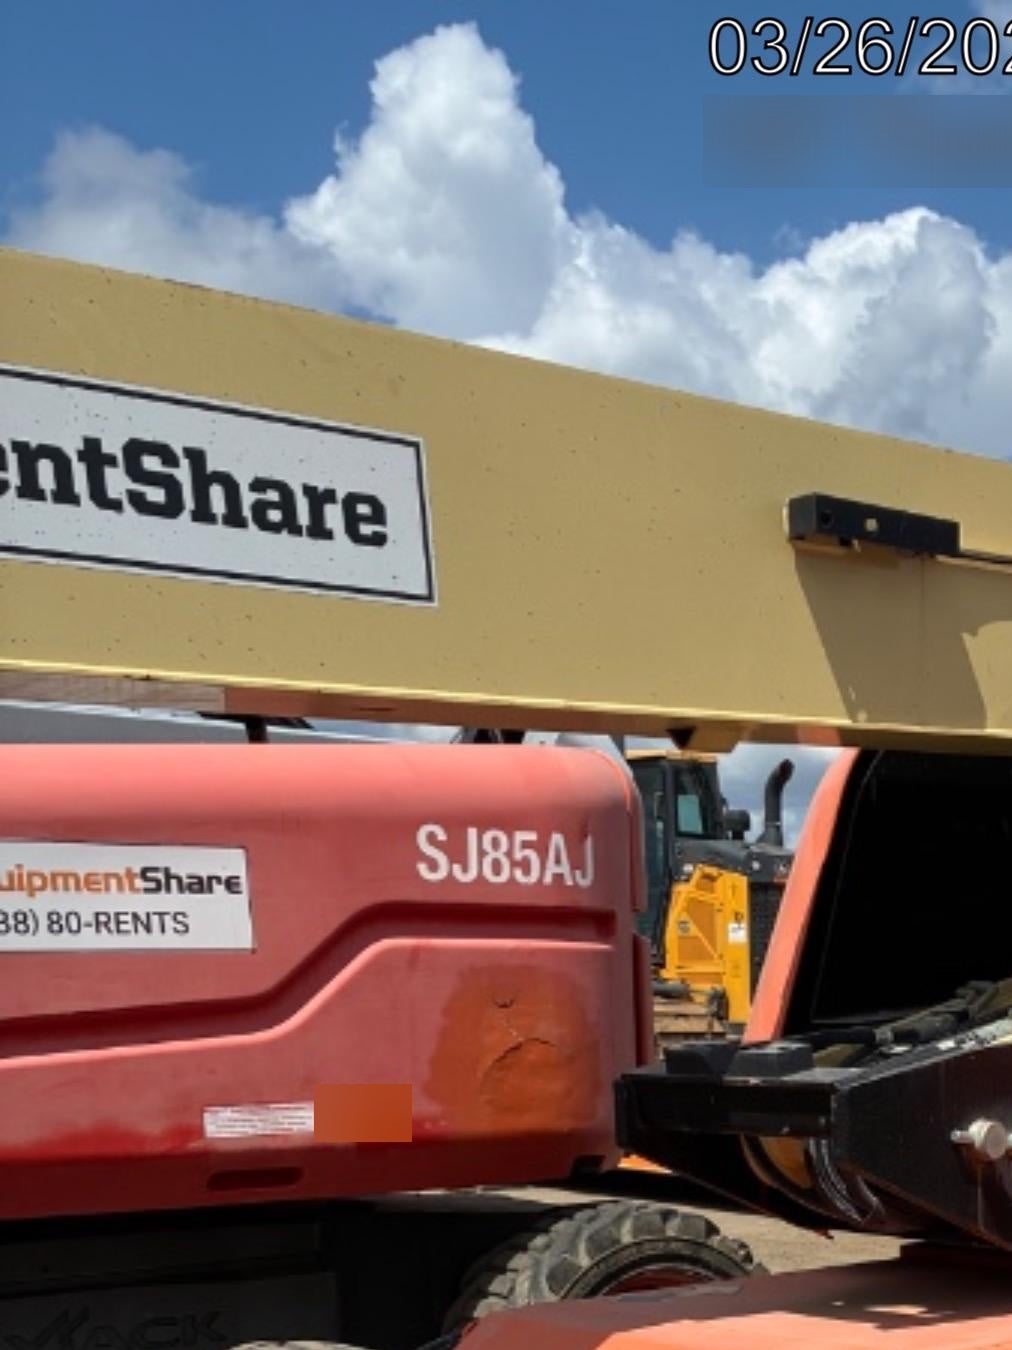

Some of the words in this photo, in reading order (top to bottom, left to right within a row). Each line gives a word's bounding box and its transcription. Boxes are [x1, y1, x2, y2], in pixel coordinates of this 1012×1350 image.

[0, 435, 390, 548] ntShare
[415, 823, 596, 888] SJ85AJ
[46, 910, 191, 935] 80-RENTS
